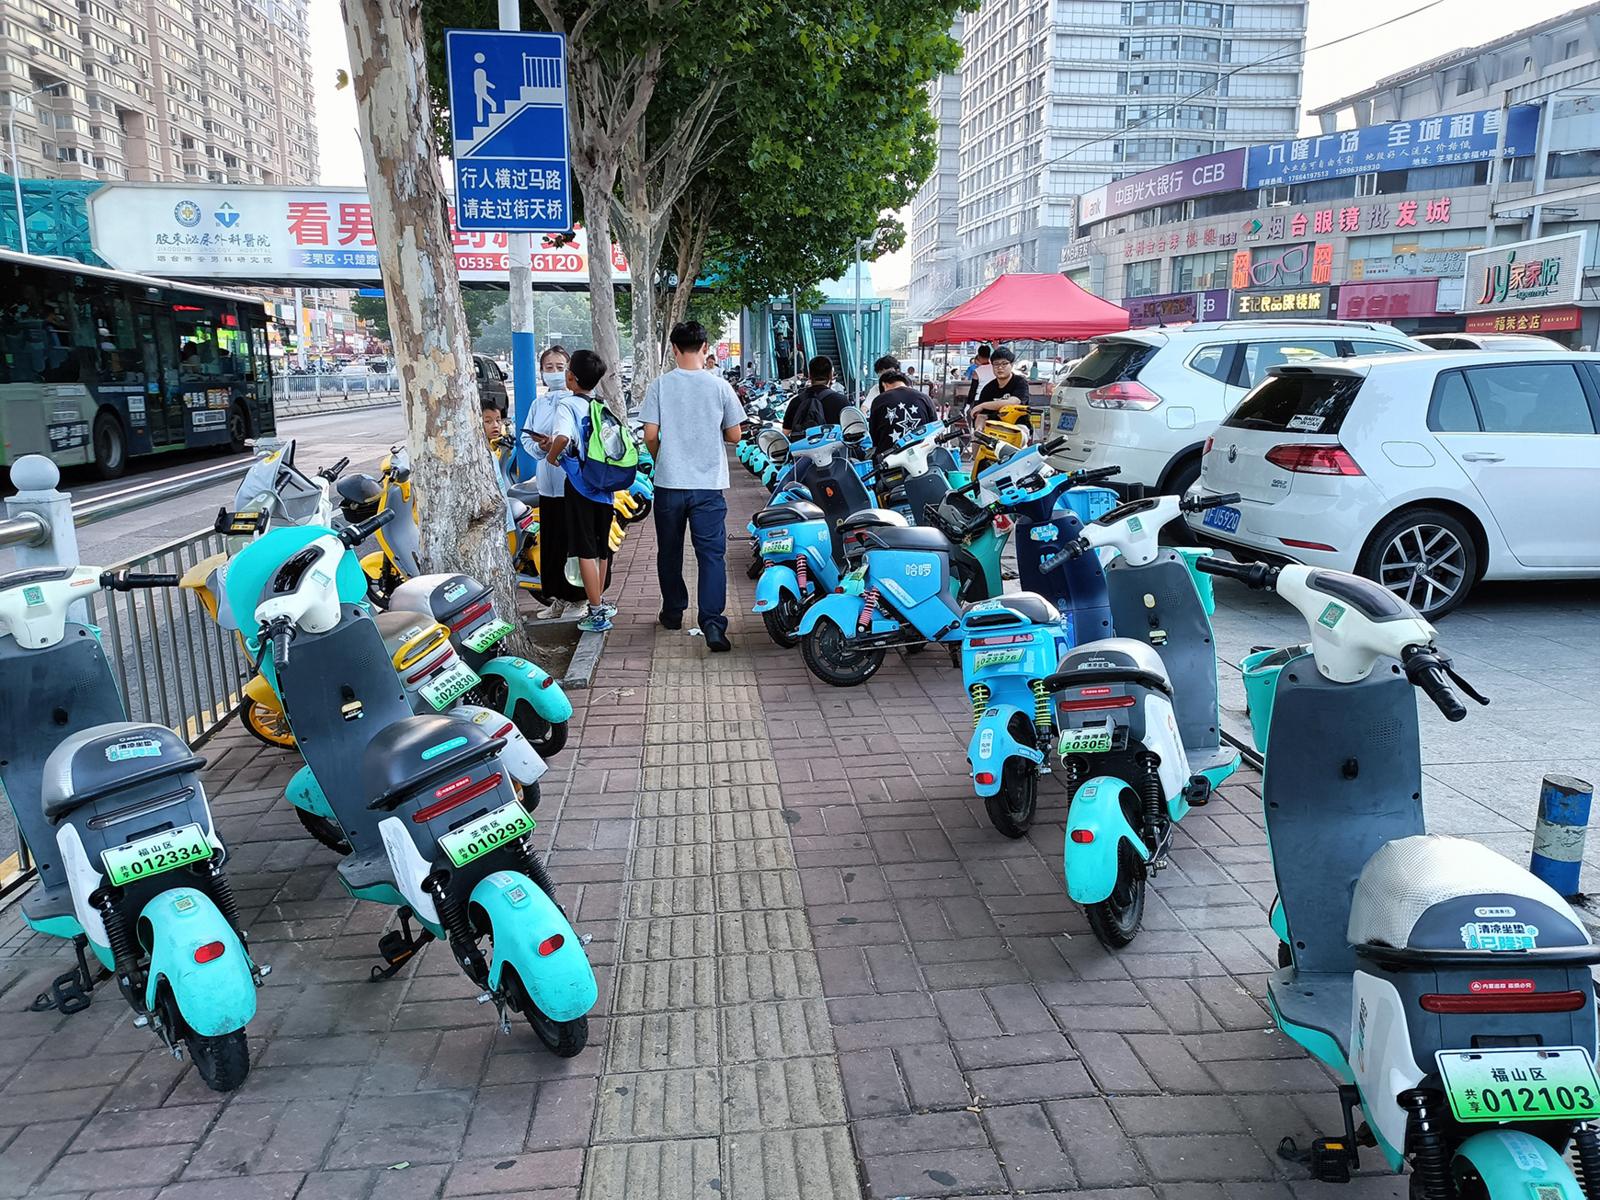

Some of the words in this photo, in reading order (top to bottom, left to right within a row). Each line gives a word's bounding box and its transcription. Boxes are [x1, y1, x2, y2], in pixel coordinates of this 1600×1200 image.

[1267, 131, 1360, 165] 九隆广场
[1387, 109, 1501, 147] 全城租售
[461, 167, 562, 191] 行人横过马路
[1115, 170, 1184, 206] 中国光大银行
[1192, 162, 1225, 187] CEB
[463, 199, 563, 220] 请走过街天桥
[1267, 197, 1451, 240] 烟台眼镜批发城
[1232, 252, 1251, 288] 网咖
[1312, 244, 1333, 284] 网咖
[1508, 257, 1561, 290] 家家悦
[1239, 293, 1322, 313] 王记良品眼镜城
[906, 563, 932, 577] 哈啰
[440, 674, 476, 701] 023830
[138, 841, 174, 858] 福山区
[467, 817, 527, 856] 010293
[131, 843, 203, 876] 012334
[1490, 1067, 1548, 1082] 福山区
[1464, 1088, 1482, 1113] 共享
[1481, 1085, 1595, 1113] 012103
